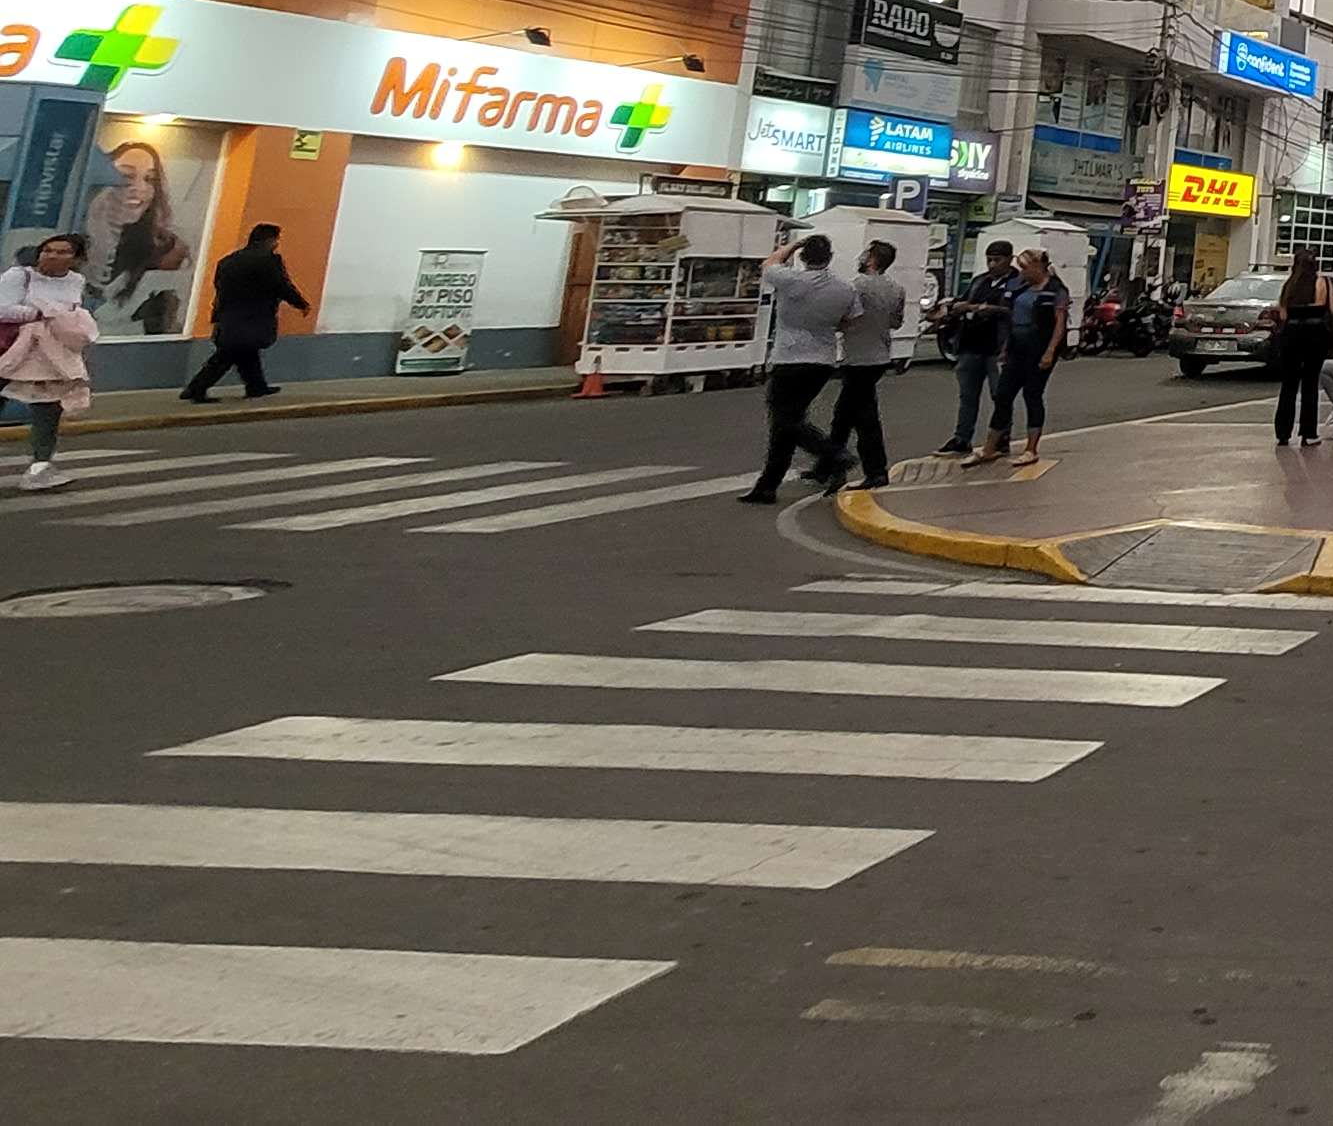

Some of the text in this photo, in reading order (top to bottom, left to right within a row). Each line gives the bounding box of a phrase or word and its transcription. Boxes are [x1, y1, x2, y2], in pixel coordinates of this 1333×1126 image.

[370, 56, 603, 137] Mifarma
[885, 122, 934, 141] LATAM
[883, 140, 932, 156] AIRLINES
[896, 180, 921, 210] P
[1181, 175, 1240, 207] DHL
[418, 273, 477, 287] INGRESO
[436, 288, 473, 303] PISO
